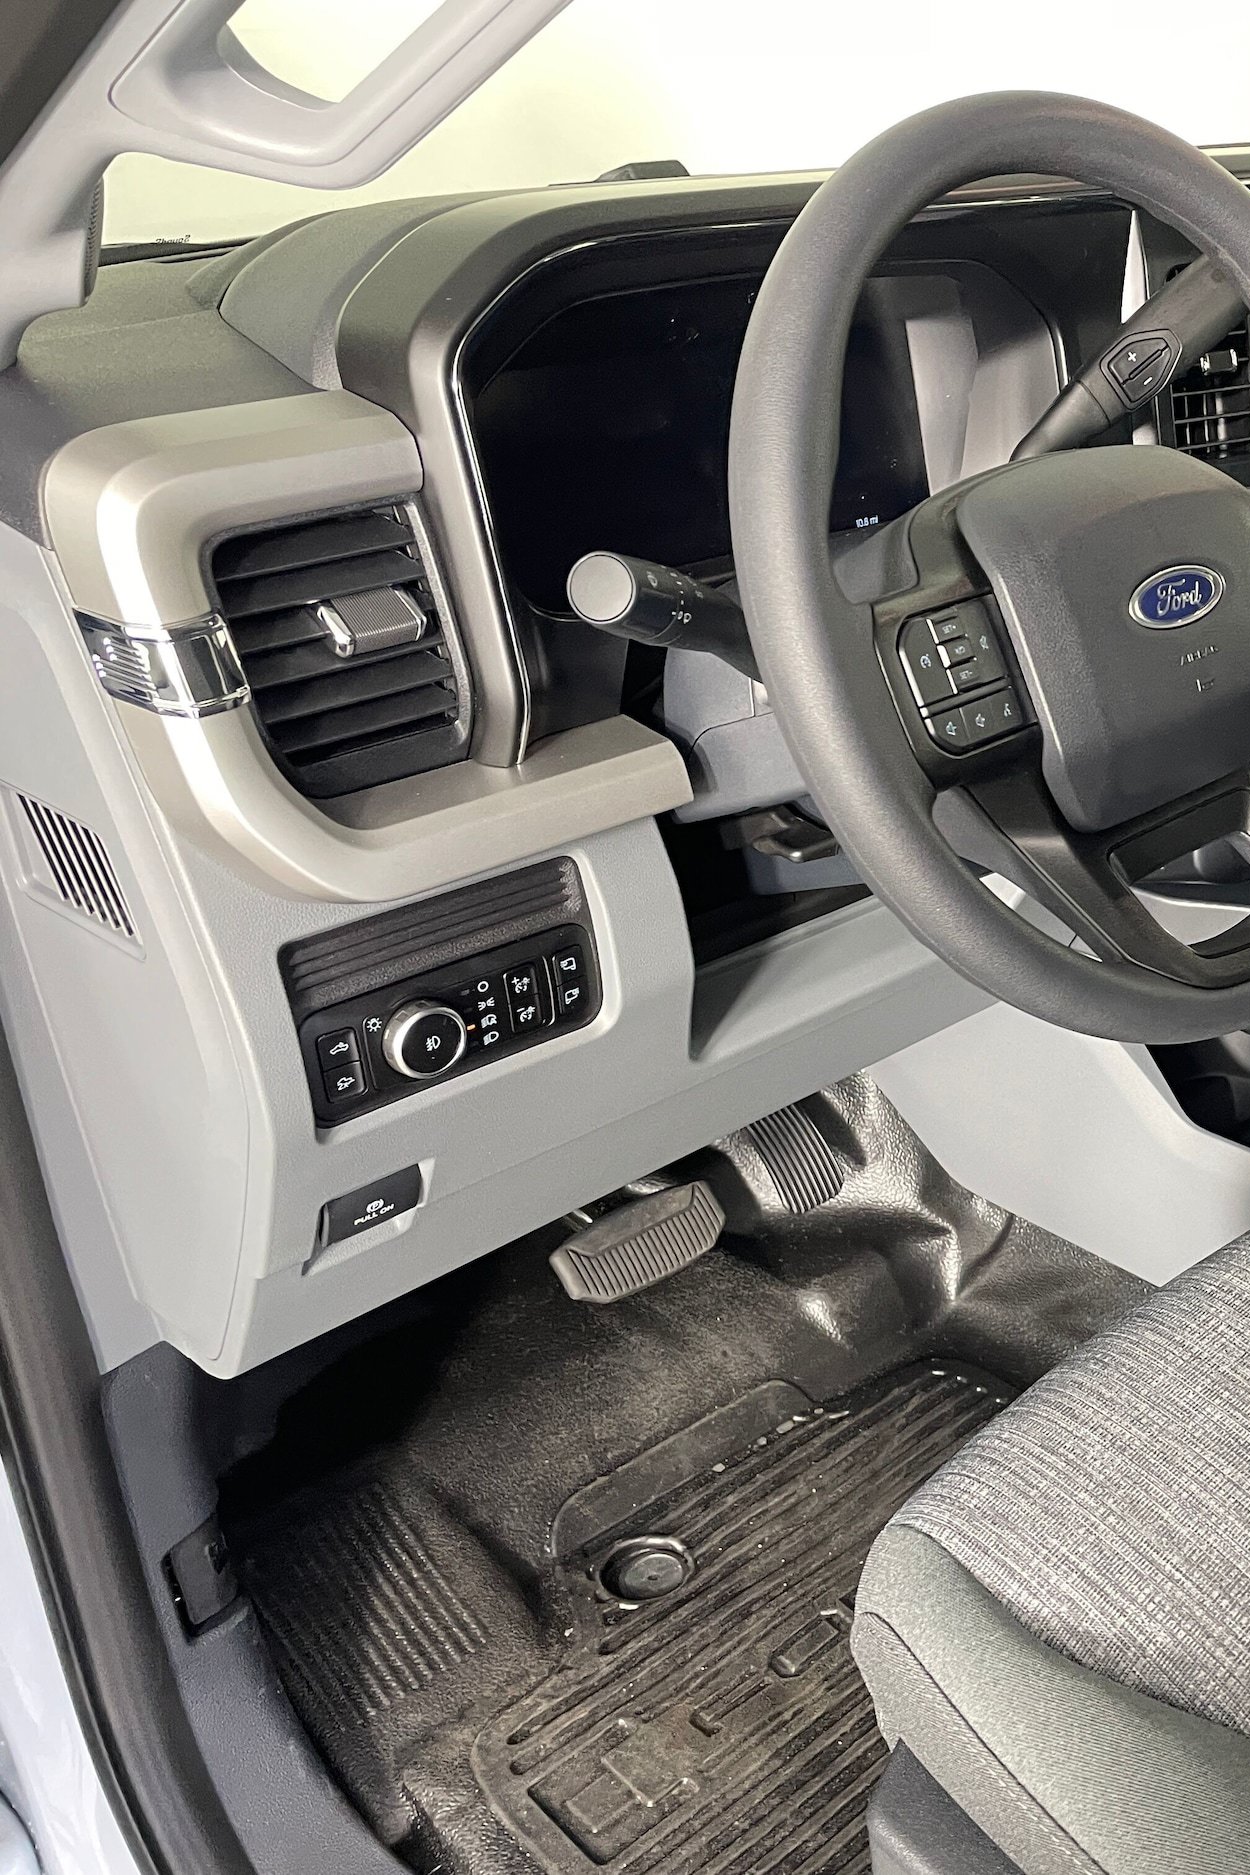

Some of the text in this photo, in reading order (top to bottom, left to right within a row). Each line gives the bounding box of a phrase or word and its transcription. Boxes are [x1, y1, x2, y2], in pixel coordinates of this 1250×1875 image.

[1157, 579, 1202, 616] Ford
[354, 1203, 394, 1225] PULL ON
